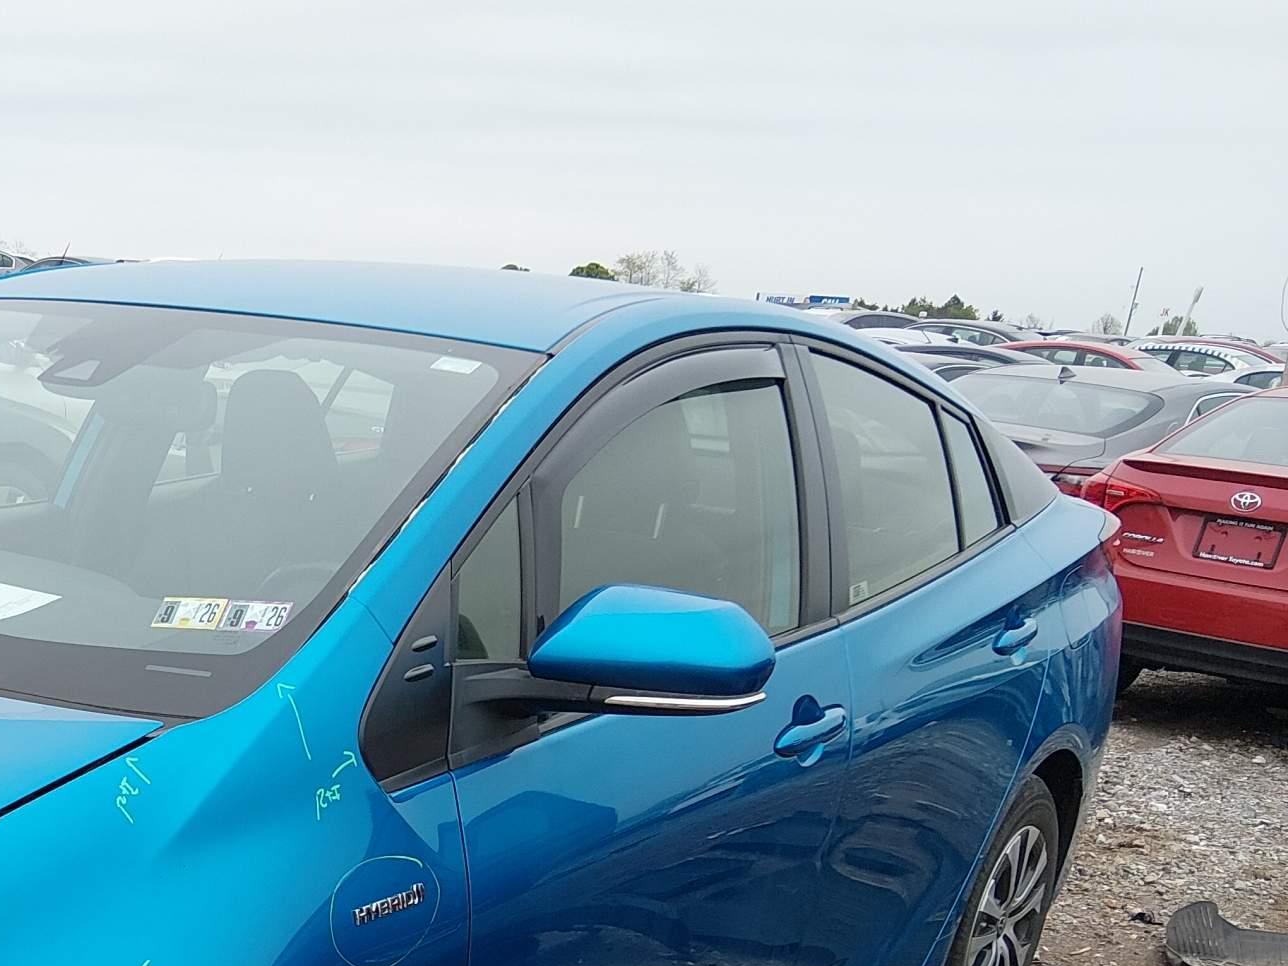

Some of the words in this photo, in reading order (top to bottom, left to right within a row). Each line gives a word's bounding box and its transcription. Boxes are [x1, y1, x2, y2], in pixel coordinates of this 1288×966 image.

[199, 603, 220, 624] 26
[266, 606, 287, 627] 26
[353, 887, 418, 926] HYBRID
